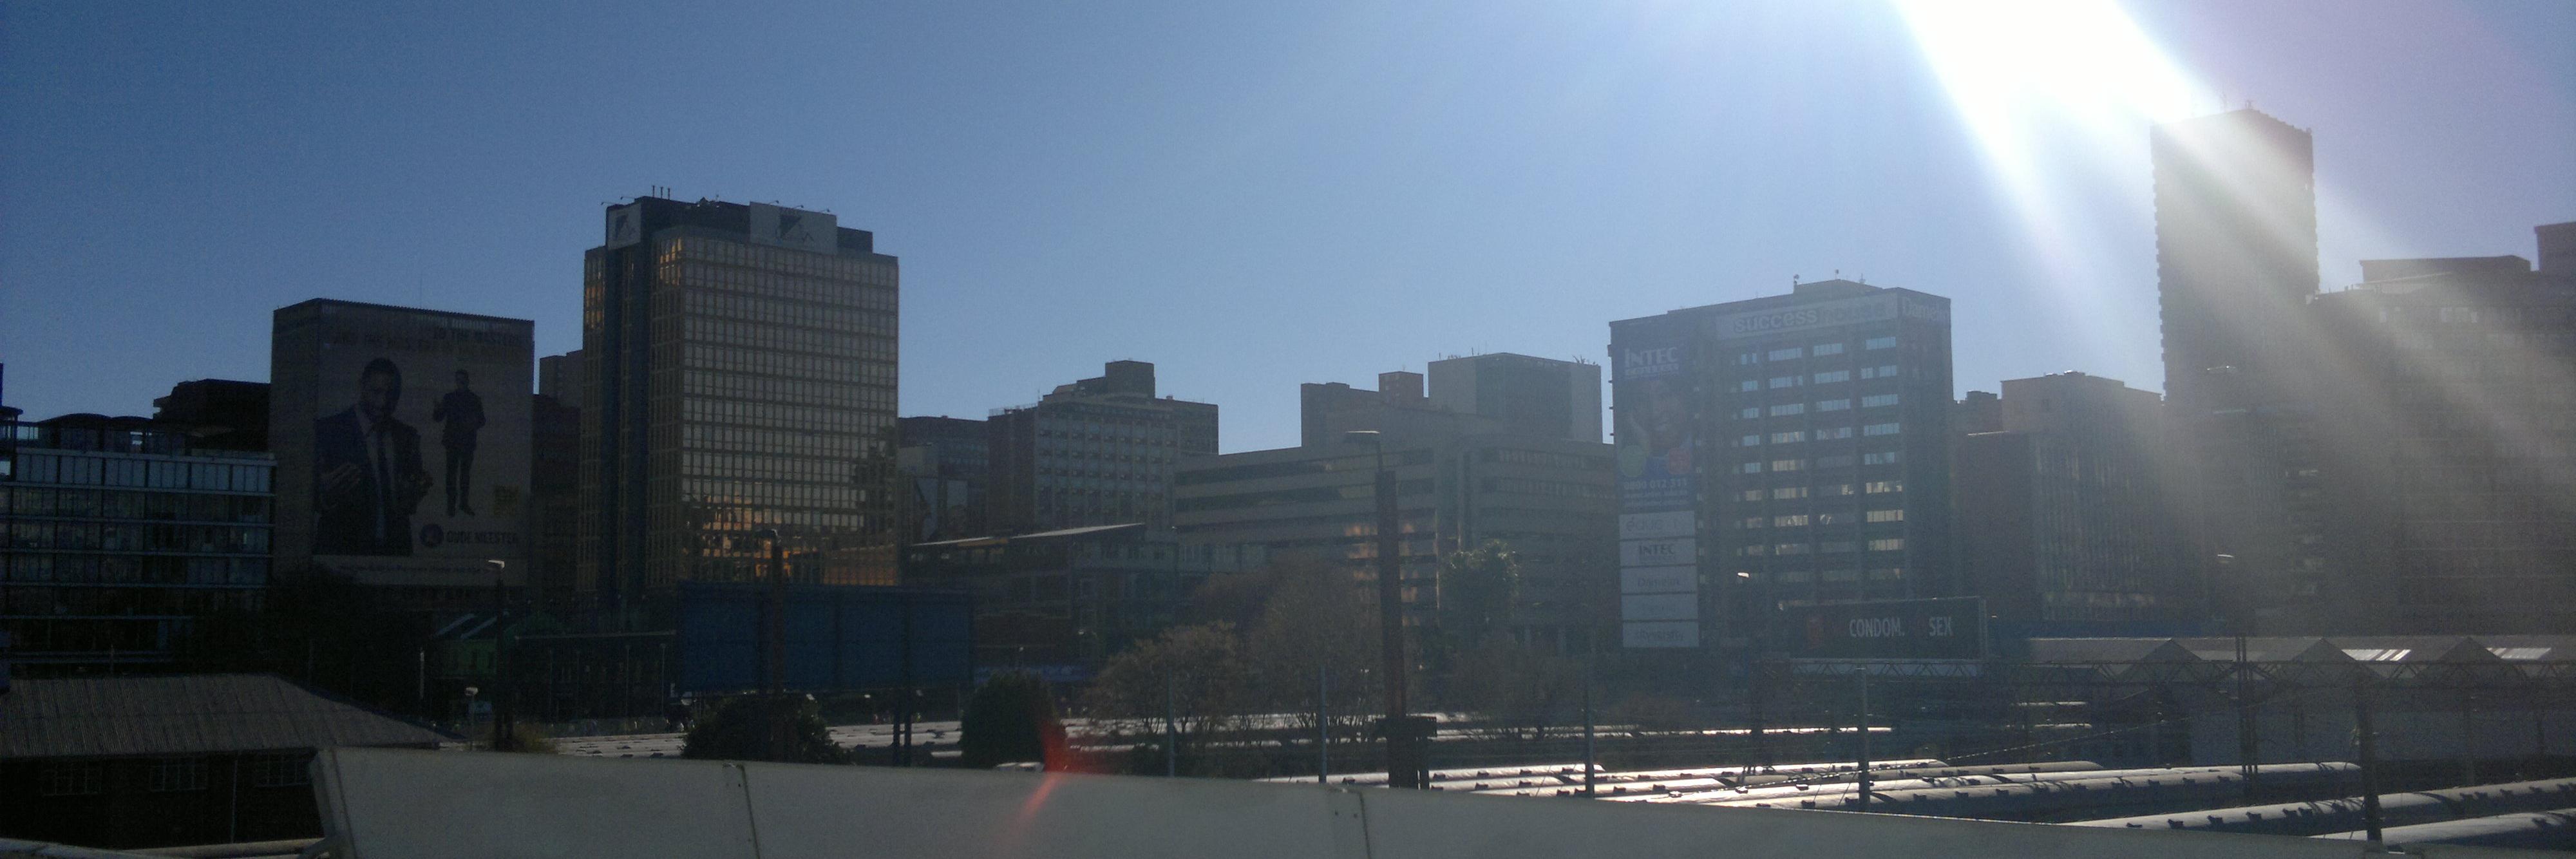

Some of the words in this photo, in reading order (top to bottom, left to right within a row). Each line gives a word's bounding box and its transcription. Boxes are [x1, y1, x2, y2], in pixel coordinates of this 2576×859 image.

[1734, 309, 1818, 333] success
[1624, 347, 1678, 368] INTEC
[1638, 543, 1675, 555] INTEC
[1849, 617, 1905, 637] CONDOM.
[1929, 616, 1953, 637] SEX
